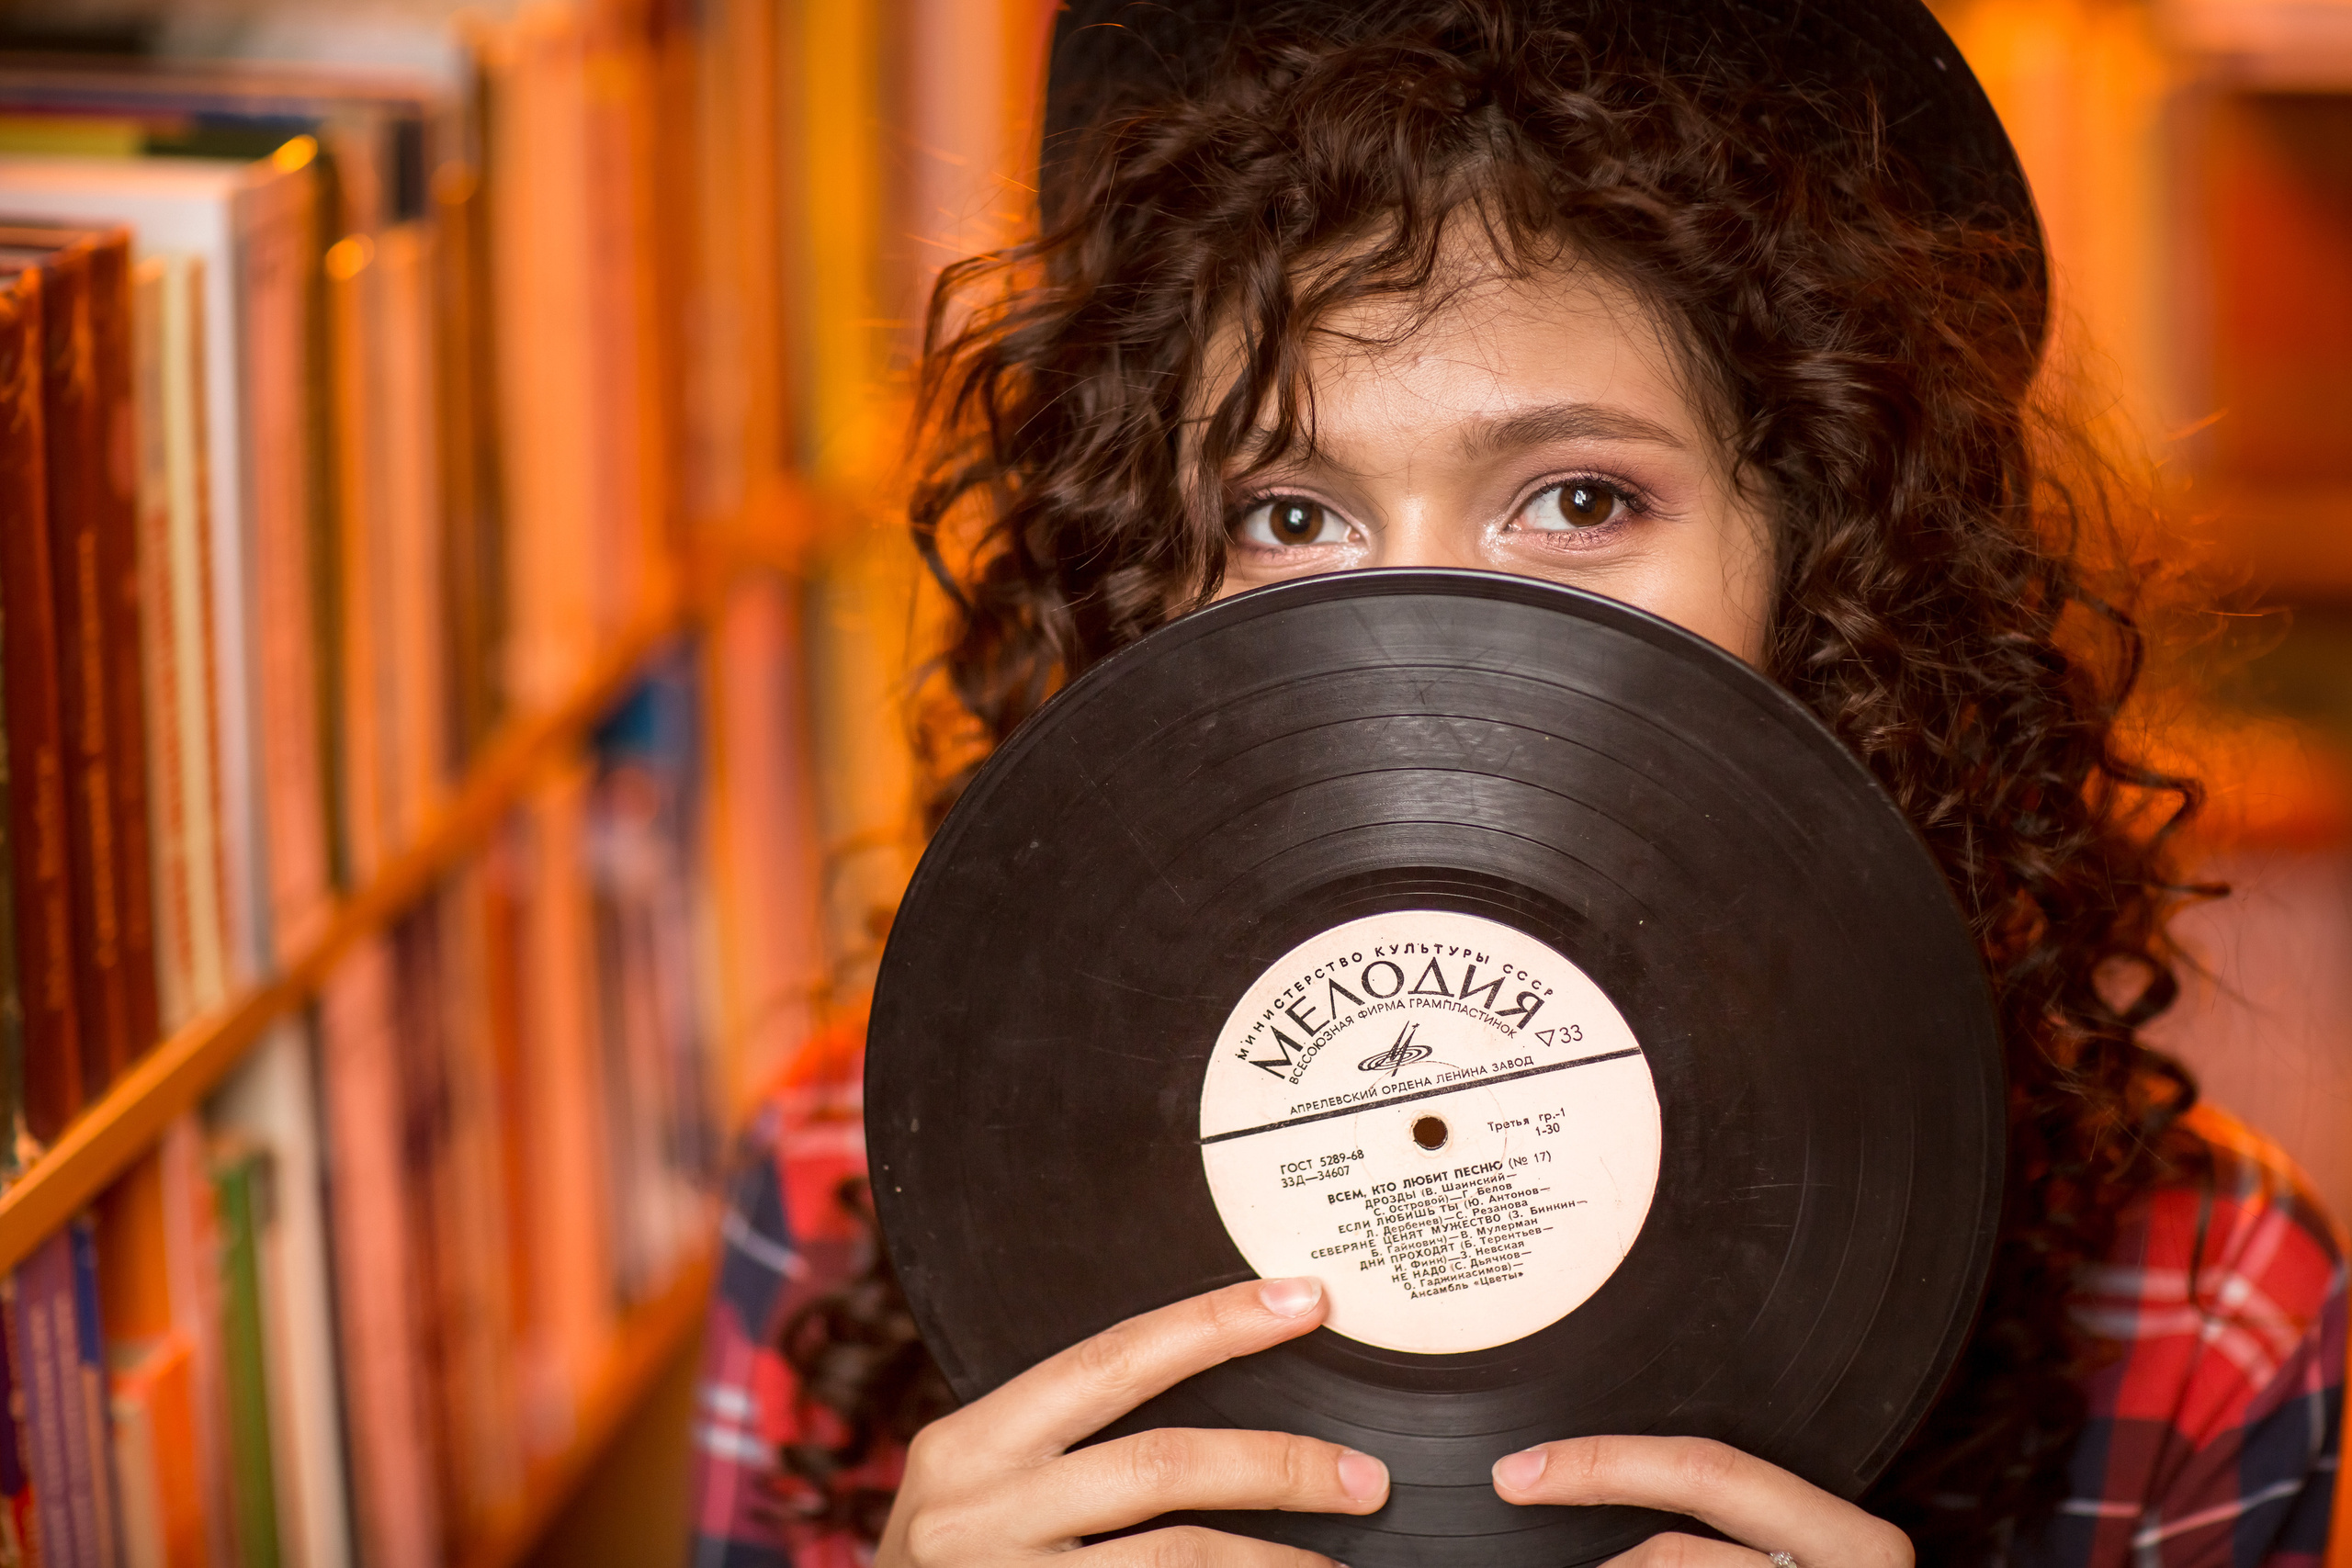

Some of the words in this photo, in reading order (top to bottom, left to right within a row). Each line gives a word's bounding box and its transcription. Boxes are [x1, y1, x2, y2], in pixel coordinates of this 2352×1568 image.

[1235, 952, 1363, 1061] МИНИСТЕРСТВО
[1374, 942, 1490, 964] КУЛЬТУРЫ
[1501, 964, 1554, 996] СССР
[1249, 956, 1545, 1080] МЕЛОДИЯ
[1288, 1015, 1355, 1085] ВСЕСОЮЗНАЯ
[1357, 999, 1406, 1019] ФИРМА
[1409, 998, 1518, 1039] ГРАМПЛАСТИНОК
[1559, 1024, 1583, 1044] 33
[1290, 1086, 1378, 1115] АПРЕЛЕВСКИЙ
[1381, 1077, 1432, 1095] ОРДЕНА
[1436, 1065, 1488, 1084] ЛЕНИНА
[1491, 1055, 1534, 1073] ЗАВОД
[1487, 1117, 1530, 1134] Третья
[1538, 1107, 1566, 1123] гр.-1
[1535, 1122, 1560, 1136] 1-30
[1280, 1158, 1312, 1175] ГОСТ
[1319, 1149, 1364, 1168] 5289-68
[1327, 1189, 1367, 1205] ВСЕМ,
[1371, 1181, 1397, 1196] КТО
[1403, 1170, 1448, 1190] ЛЮБИТ
[1453, 1160, 1503, 1179] ПЕСНЮ
[1508, 1156, 1529, 1170] (№
[1533, 1150, 1552, 1163] 17)
[1338, 1220, 1371, 1234] ЕСЛИ
[1376, 1207, 1436, 1226] ЛЮБИШЬ
[1439, 1202, 1459, 1213] ТЫ
[1464, 1197, 1484, 1210] (Ю.
[1365, 1190, 1417, 1211] ДРОЗДЫ
[1421, 1187, 1437, 1198] (В.
[1373, 1207, 1385, 1216] С.
[1476, 1183, 1513, 1196] Белов
[1366, 1229, 1378, 1238] Л.
[1472, 1200, 1529, 1217] Резанова
[1310, 1238, 1376, 1259] СЕВЕРЯНЕ
[1383, 1228, 1423, 1246] ЦЕНЯТ
[1430, 1213, 1501, 1235] МУЖЕСТВО
[1371, 1247, 1385, 1258] Б.
[1476, 1218, 1538, 1236] Мулерман
[1360, 1258, 1385, 1271] ДНИ
[1390, 1242, 1454, 1264] ПРОХОДЯТ
[1460, 1239, 1476, 1250] (Б.
[1393, 1262, 1409, 1273] И.
[1475, 1240, 1525, 1257] Невская
[1391, 1272, 1408, 1283] НЕ
[1412, 1265, 1447, 1279] НАДО
[1451, 1261, 1466, 1271] (С.
[1403, 1281, 1416, 1291] О.
[1410, 1283, 1469, 1300] Ансамбль
[1474, 1271, 1524, 1286] «Цветы»
